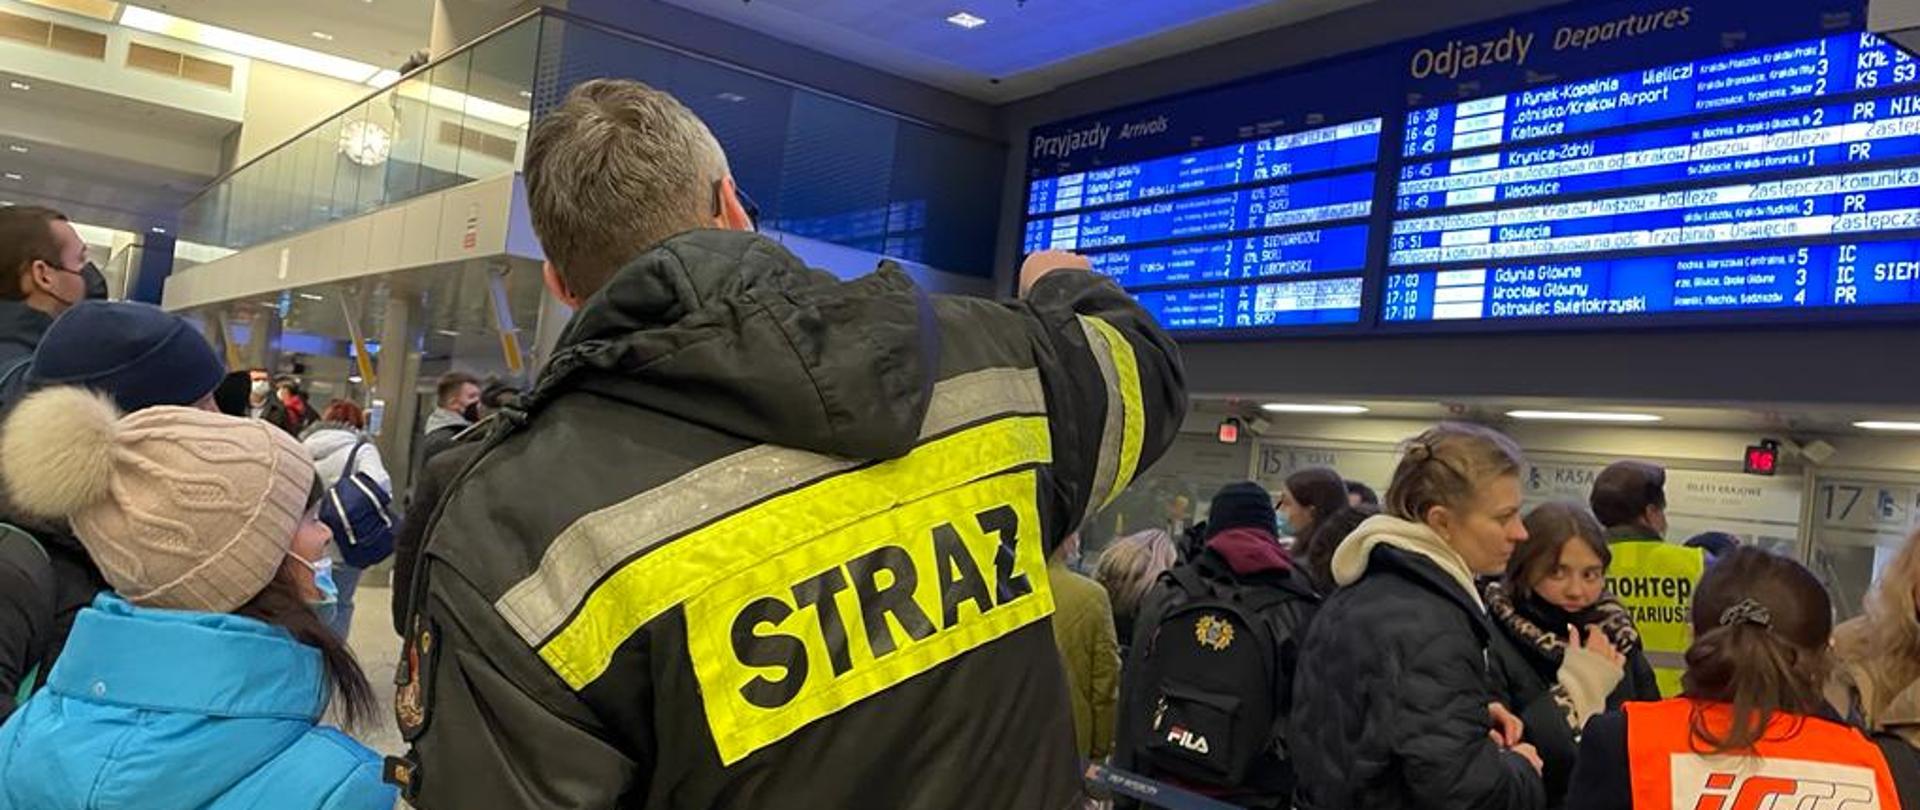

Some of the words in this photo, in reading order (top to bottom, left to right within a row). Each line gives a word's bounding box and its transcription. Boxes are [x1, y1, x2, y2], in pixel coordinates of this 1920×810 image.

[1410, 28, 1534, 79] Odjazdy
[1553, 6, 1691, 51] Departures
[1817, 59, 1829, 75] 3
[1511, 121, 1564, 141] Katowice
[1815, 78, 1827, 96] 2
[1855, 70, 1878, 90] KS
[1893, 63, 1916, 83] S3
[1812, 108, 1824, 126] 2
[1853, 101, 1876, 120] PR
[1033, 122, 1111, 158] Przyjazdy
[1118, 116, 1168, 140] Arrivals
[1807, 149, 1815, 166] 1
[1848, 142, 1872, 161] PR
[1803, 199, 1814, 216] 3
[1843, 194, 1867, 213] PR
[1797, 248, 1809, 265] 5
[1838, 245, 1857, 263] IC
[1796, 268, 1807, 286] 3
[1836, 266, 1855, 284] IC
[1491, 301, 1551, 317] Ostrowiec
[1794, 289, 1806, 305] 4
[1834, 286, 1858, 304] PR
[1263, 450, 1281, 474] 15
[1749, 450, 1773, 471] 16
[1555, 468, 1595, 484] KASA
[1823, 484, 1863, 520] 17
[1167, 726, 1209, 754] FILA
